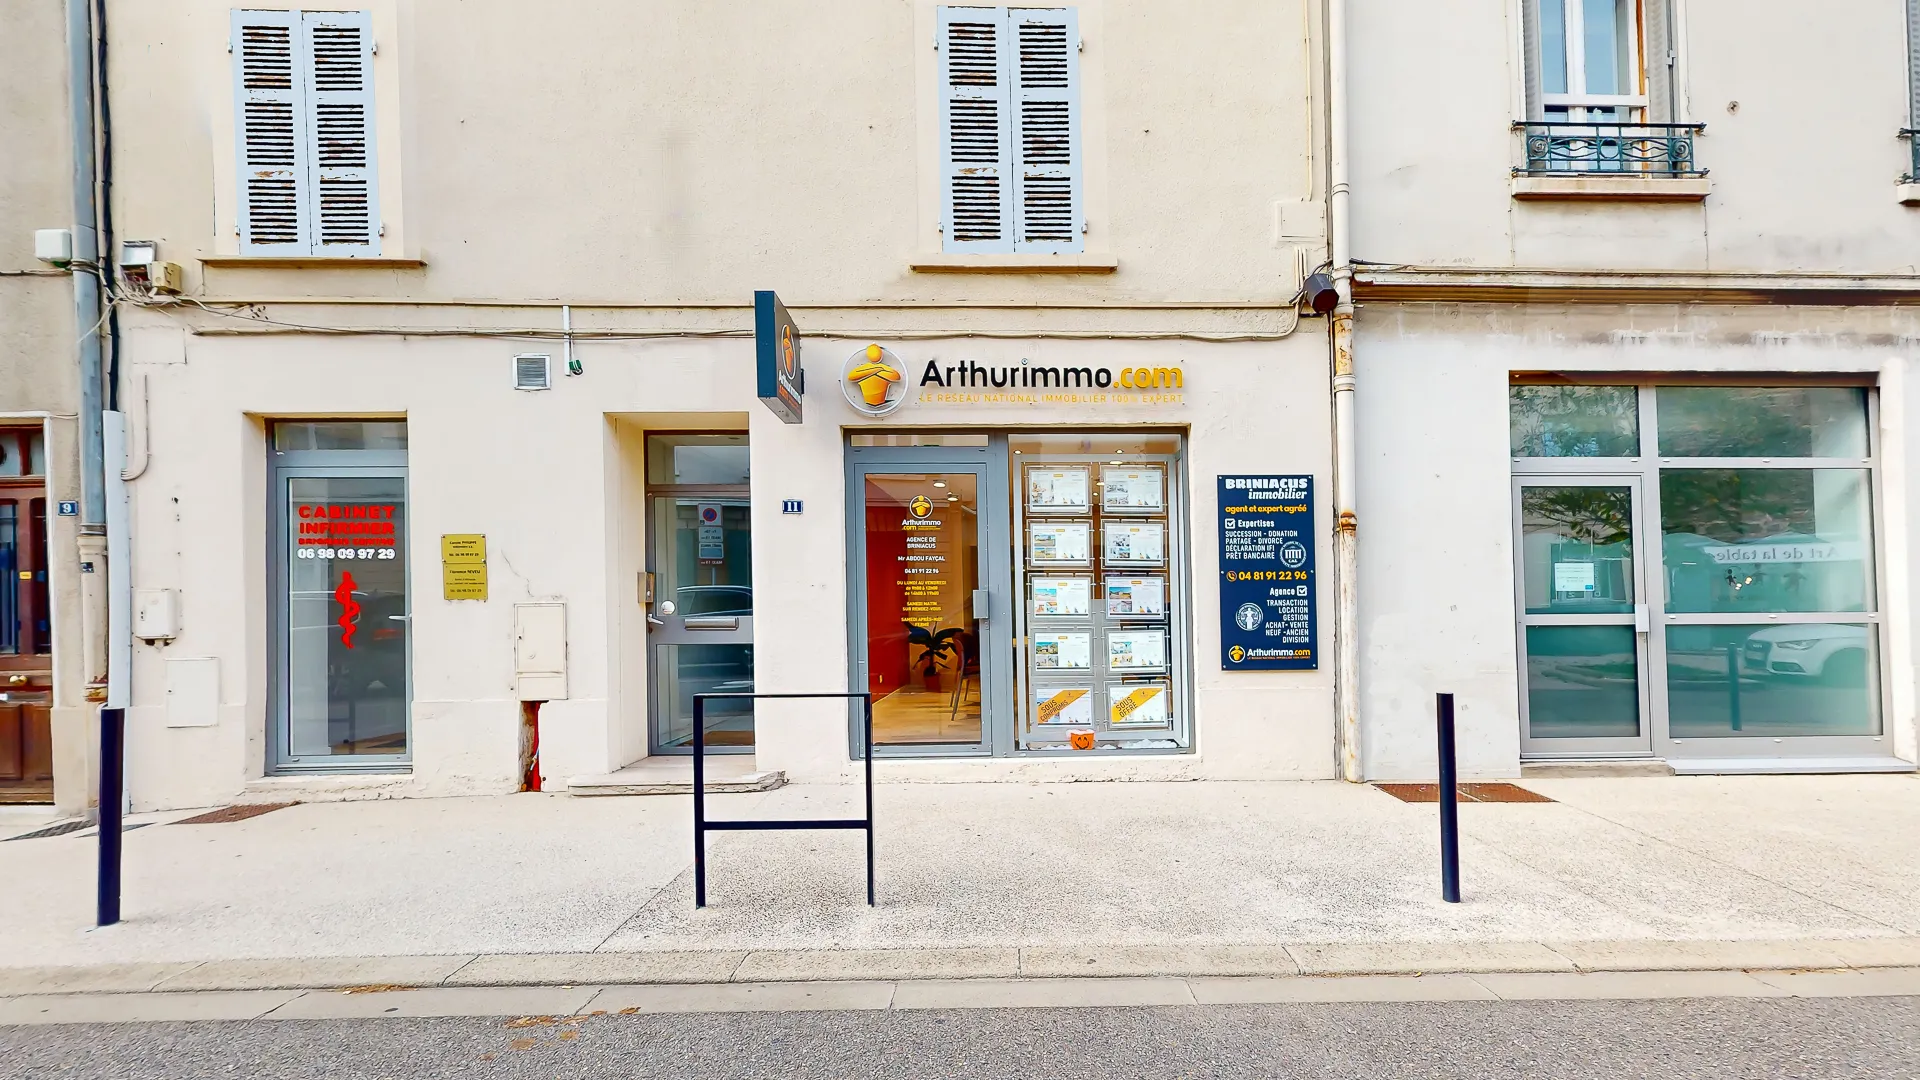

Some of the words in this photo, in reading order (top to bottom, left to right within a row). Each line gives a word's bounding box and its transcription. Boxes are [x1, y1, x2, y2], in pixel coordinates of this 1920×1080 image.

[919, 358, 1183, 388] Arthurimmo.com
[920, 393, 932, 402] LE
[984, 393, 1037, 402] NATIONAL
[1042, 394, 1106, 402] IMMOBILIER
[1142, 394, 1183, 402] EXPERT
[1225, 478, 1308, 489] BRINIACUS
[1248, 488, 1308, 500] immobilier
[62, 503, 72, 513] 9
[298, 505, 396, 519] CABINET
[787, 502, 799, 512] 11
[1225, 505, 1248, 514] agent
[1257, 505, 1283, 514] expert
[1284, 504, 1307, 514] agréé
[299, 522, 396, 535] INFIRMIER
[1238, 519, 1275, 529] Expertises
[297, 548, 315, 559] 06
[317, 548, 336, 559] 98
[337, 548, 356, 559] 09
[357, 548, 376, 559] 97
[377, 548, 396, 559] 29
[1226, 551, 1242, 559] PRÊT
[1238, 571, 1251, 580] 04
[1253, 571, 1264, 580] 81
[1265, 571, 1276, 580] 91
[1278, 571, 1292, 580] 22
[1294, 571, 1308, 580] 96
[1269, 587, 1295, 597] Agence
[1247, 648, 1311, 656] Arthurimmo.com
[1041, 700, 1058, 713] SOUS
[1116, 696, 1133, 711] SOUS
[1040, 700, 1069, 722] COMPROMIS
[1119, 701, 1139, 718] OFFRE
